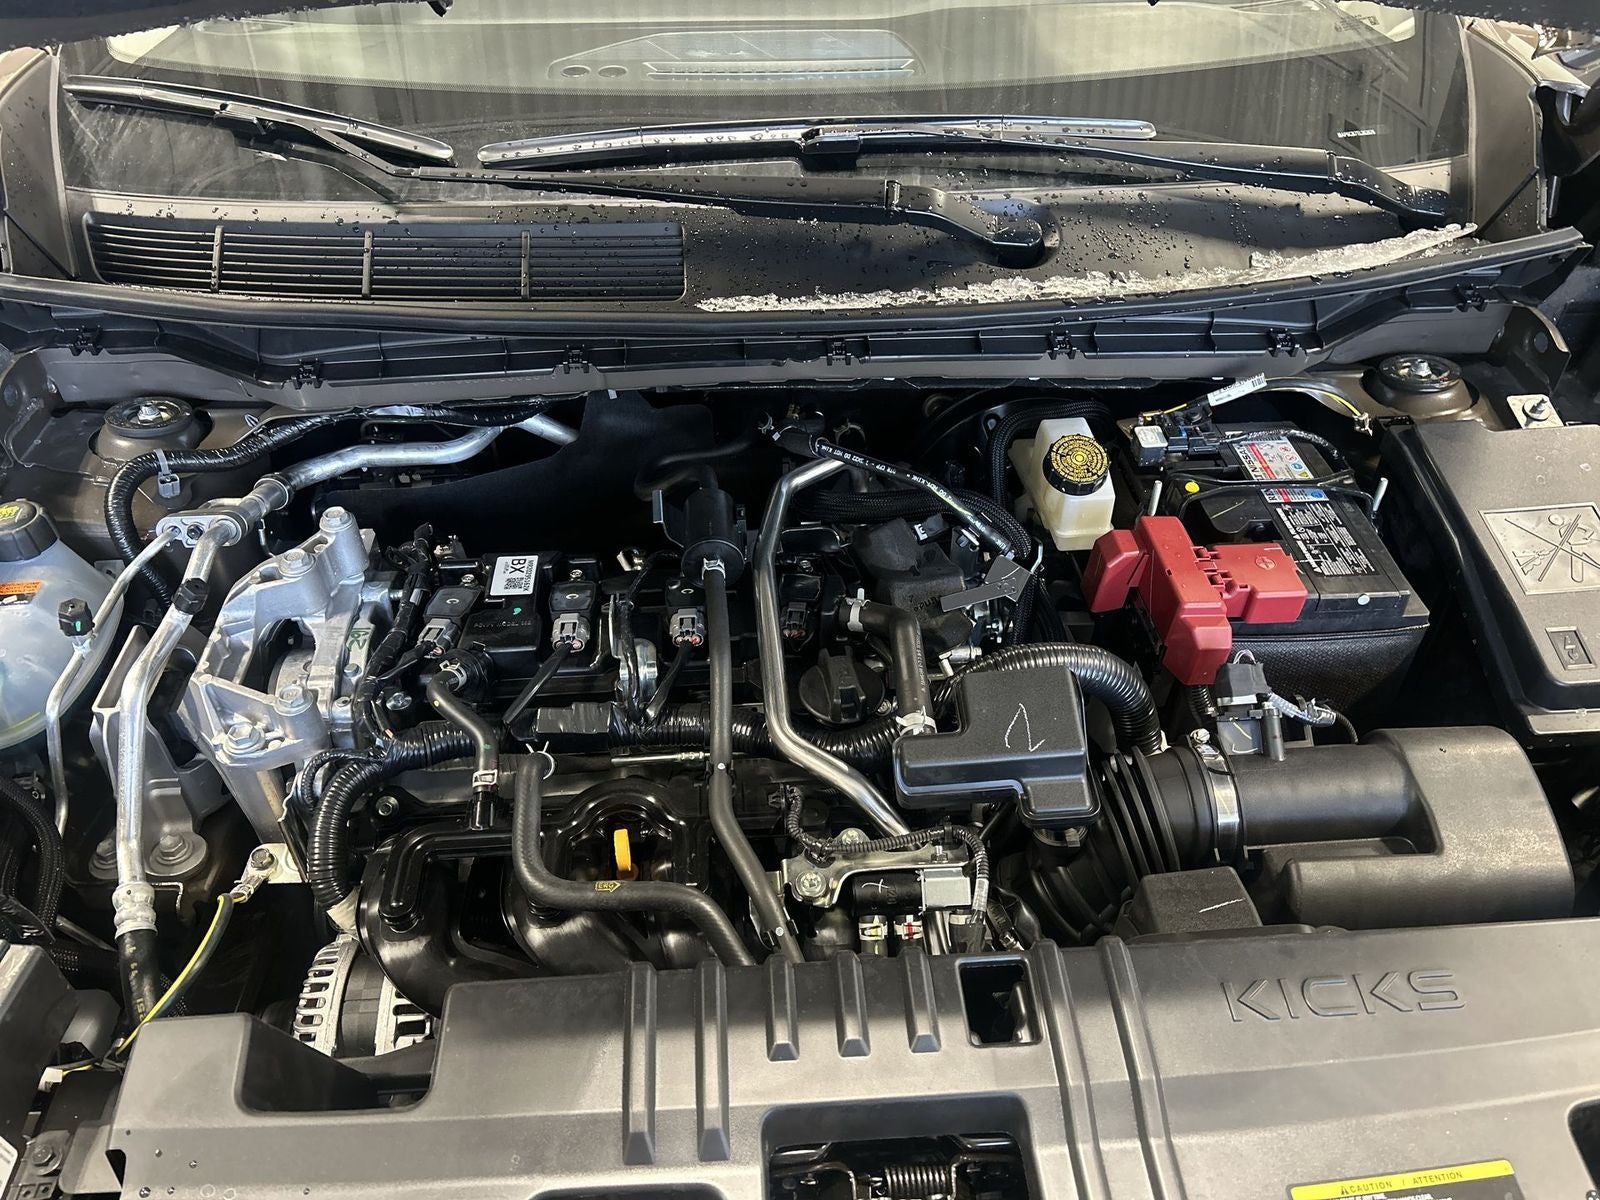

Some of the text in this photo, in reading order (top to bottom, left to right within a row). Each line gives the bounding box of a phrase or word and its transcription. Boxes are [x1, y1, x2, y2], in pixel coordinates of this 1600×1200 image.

[509, 558, 527, 574] BX
[1220, 969, 1465, 1022] KICKS
[1350, 1182, 1393, 1193] CAUTION
[1413, 1171, 1463, 1185] ATTENTION
